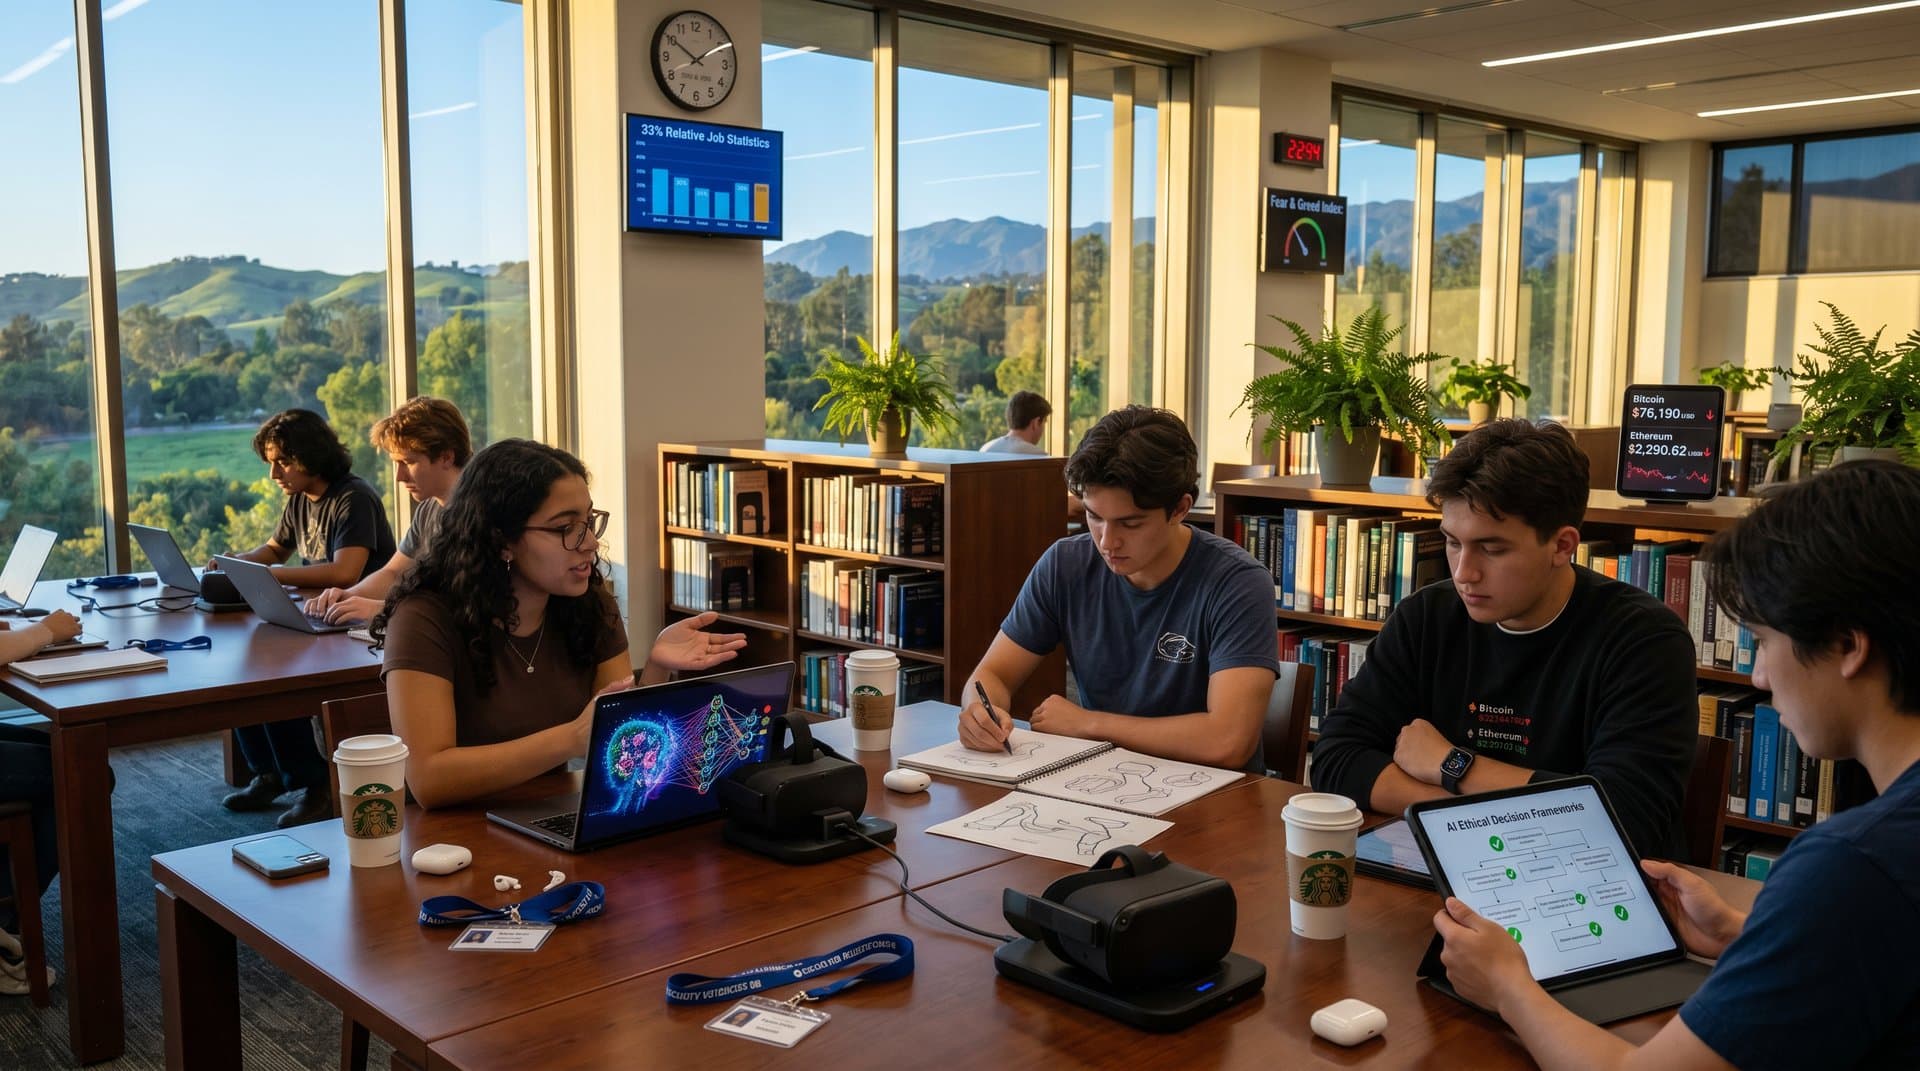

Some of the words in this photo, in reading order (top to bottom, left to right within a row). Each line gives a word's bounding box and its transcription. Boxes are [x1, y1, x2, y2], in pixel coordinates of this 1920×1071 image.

[676, 23, 686, 35] 11
[690, 21, 701, 33] 12
[666, 34, 677, 46] 10
[707, 28, 712, 40] 1
[662, 51, 669, 62] 9
[722, 59, 729, 70] 3
[667, 69, 675, 80] 8
[718, 77, 724, 87] 4
[680, 83, 686, 94] 7
[707, 87, 714, 98] 5
[693, 91, 700, 101] 6
[641, 123, 664, 137] 33%
[665, 126, 705, 141] Relative
[706, 131, 725, 143] Job
[726, 133, 771, 149] Statistics
[1270, 194, 1288, 209] Fear
[1289, 196, 1297, 210] &
[1297, 197, 1321, 213] Greed
[1633, 395, 1665, 404] Bitcoin
[1632, 407, 1681, 420] $76,190
[1630, 431, 1673, 441] Ethereum
[1628, 443, 1687, 456] $2,290.62
[1479, 703, 1514, 715] Bitcoin
[1446, 821, 1458, 832] AI
[1459, 816, 1491, 831] Ethical
[1490, 810, 1531, 825] Decision
[1530, 802, 1585, 818] Frameworks
